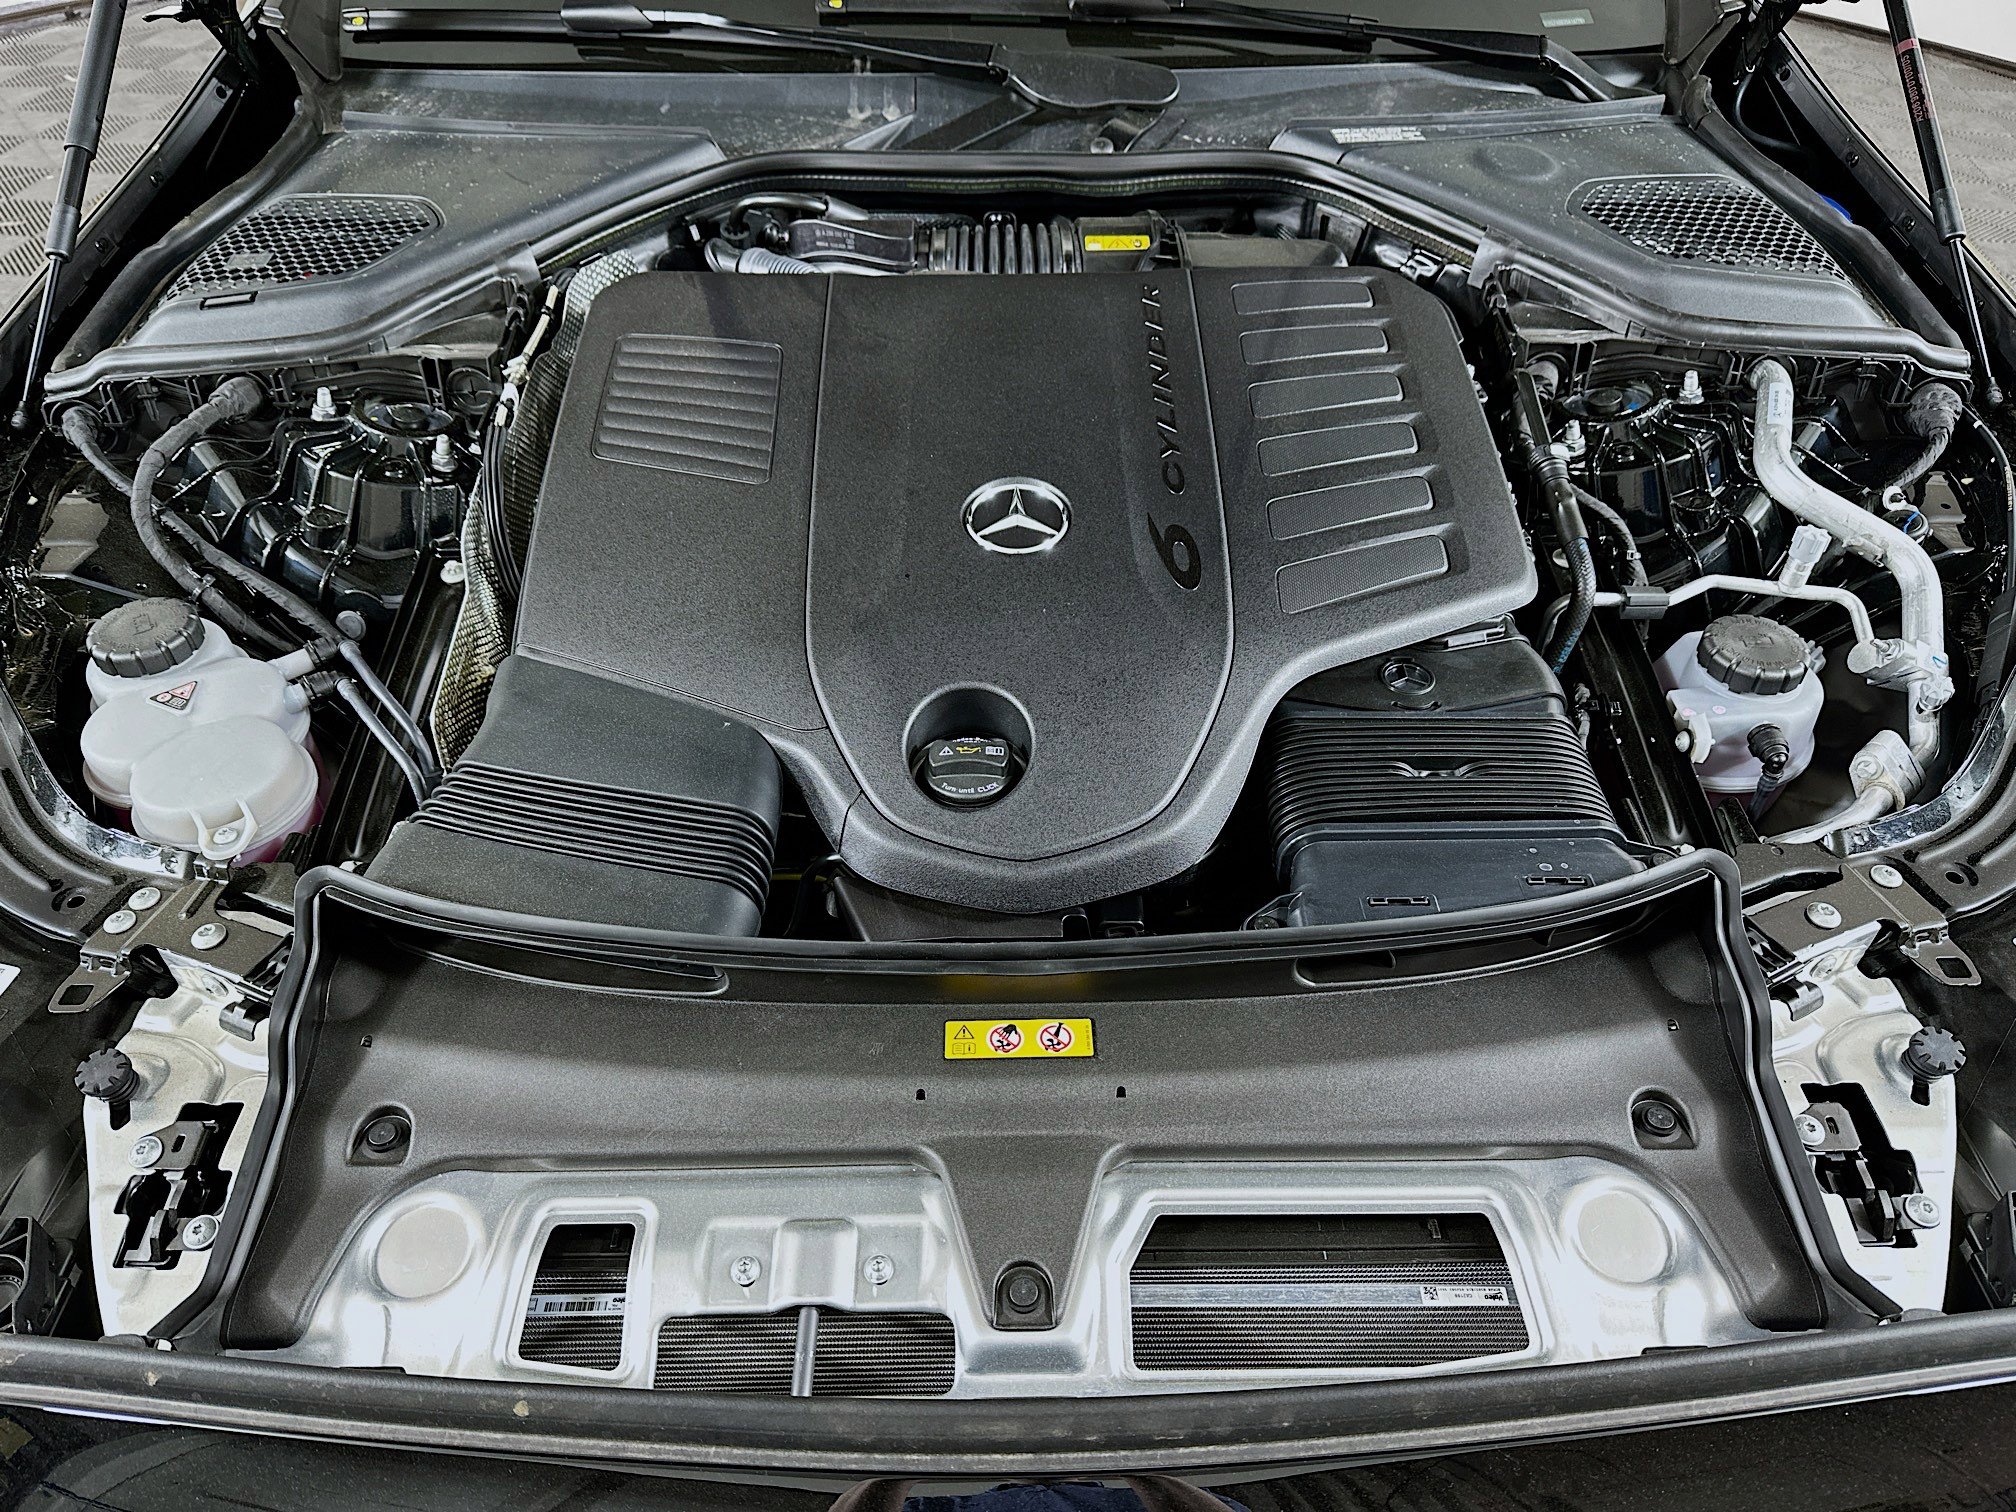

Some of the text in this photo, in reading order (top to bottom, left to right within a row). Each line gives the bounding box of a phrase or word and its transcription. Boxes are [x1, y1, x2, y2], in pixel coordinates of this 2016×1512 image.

[1141, 285, 1201, 590] 6 CYLINDER
[941, 782, 957, 792] Turn
[977, 782, 999, 793] CLICK
